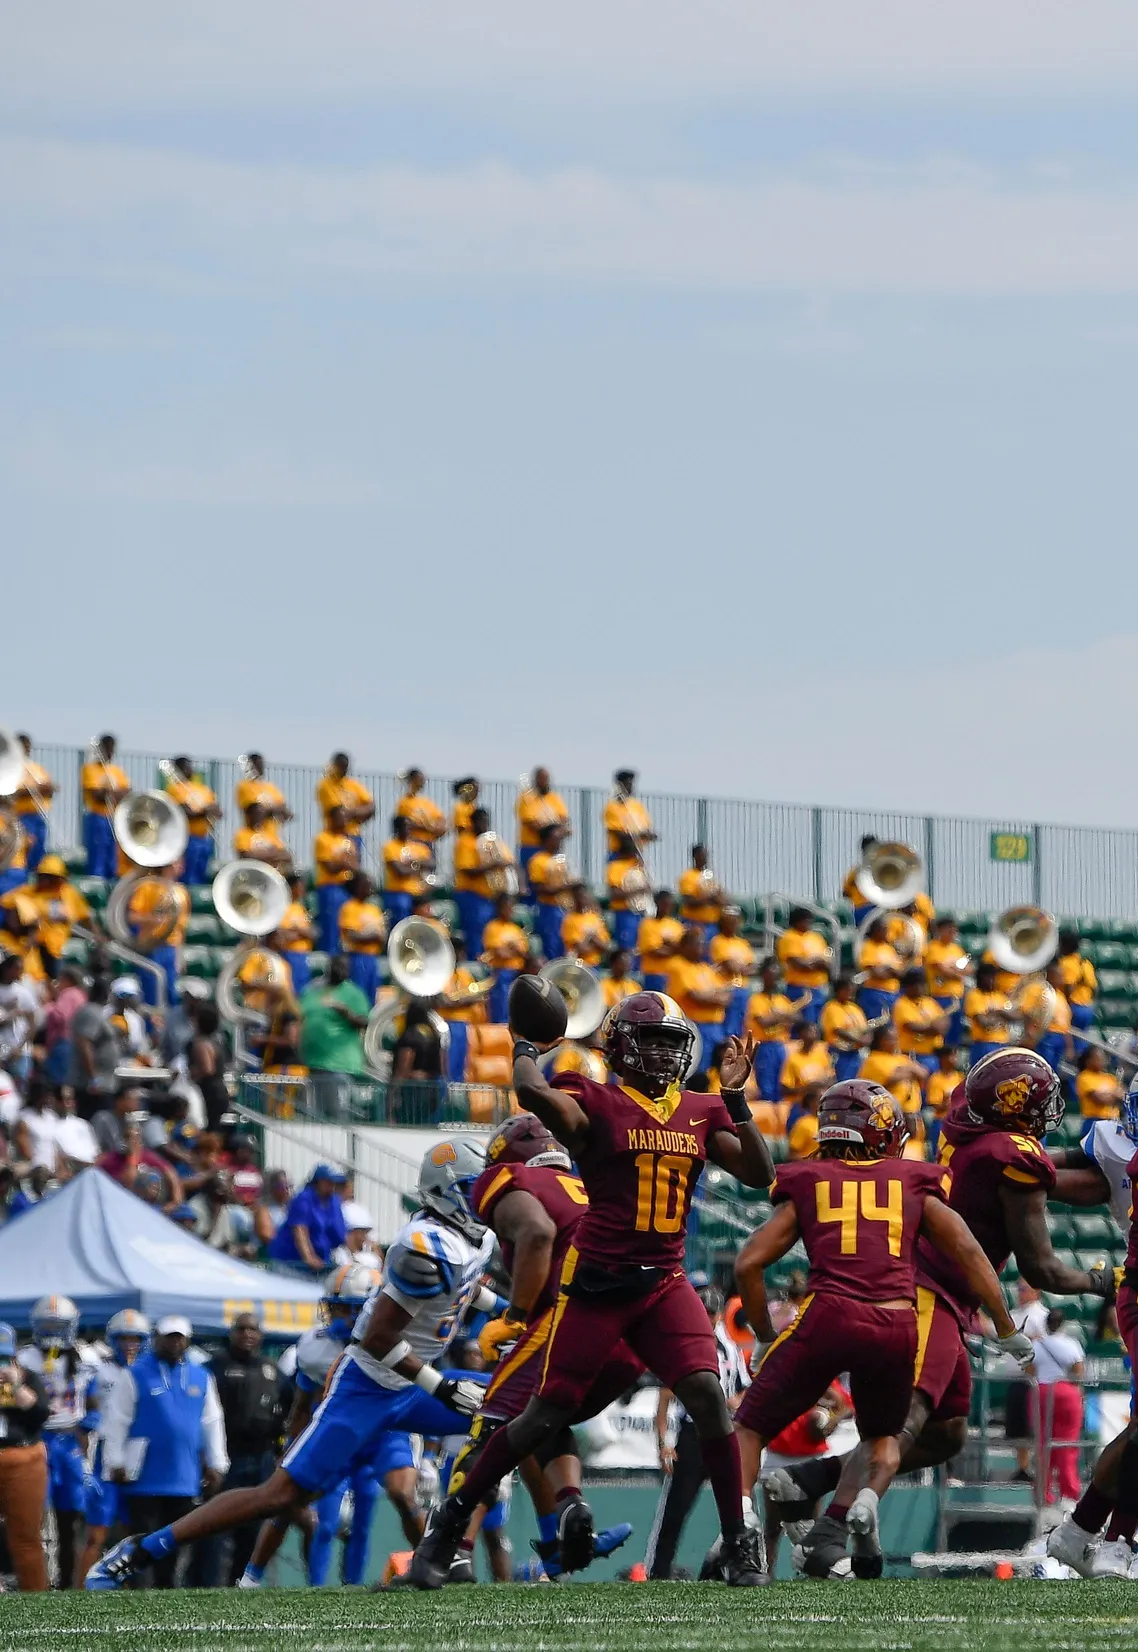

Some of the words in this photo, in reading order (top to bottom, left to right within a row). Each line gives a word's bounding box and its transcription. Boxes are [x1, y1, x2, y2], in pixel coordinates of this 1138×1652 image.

[627, 1128, 699, 1155] MARAUDERS
[634, 1153, 693, 1234] 10
[814, 1179, 903, 1258] 44
